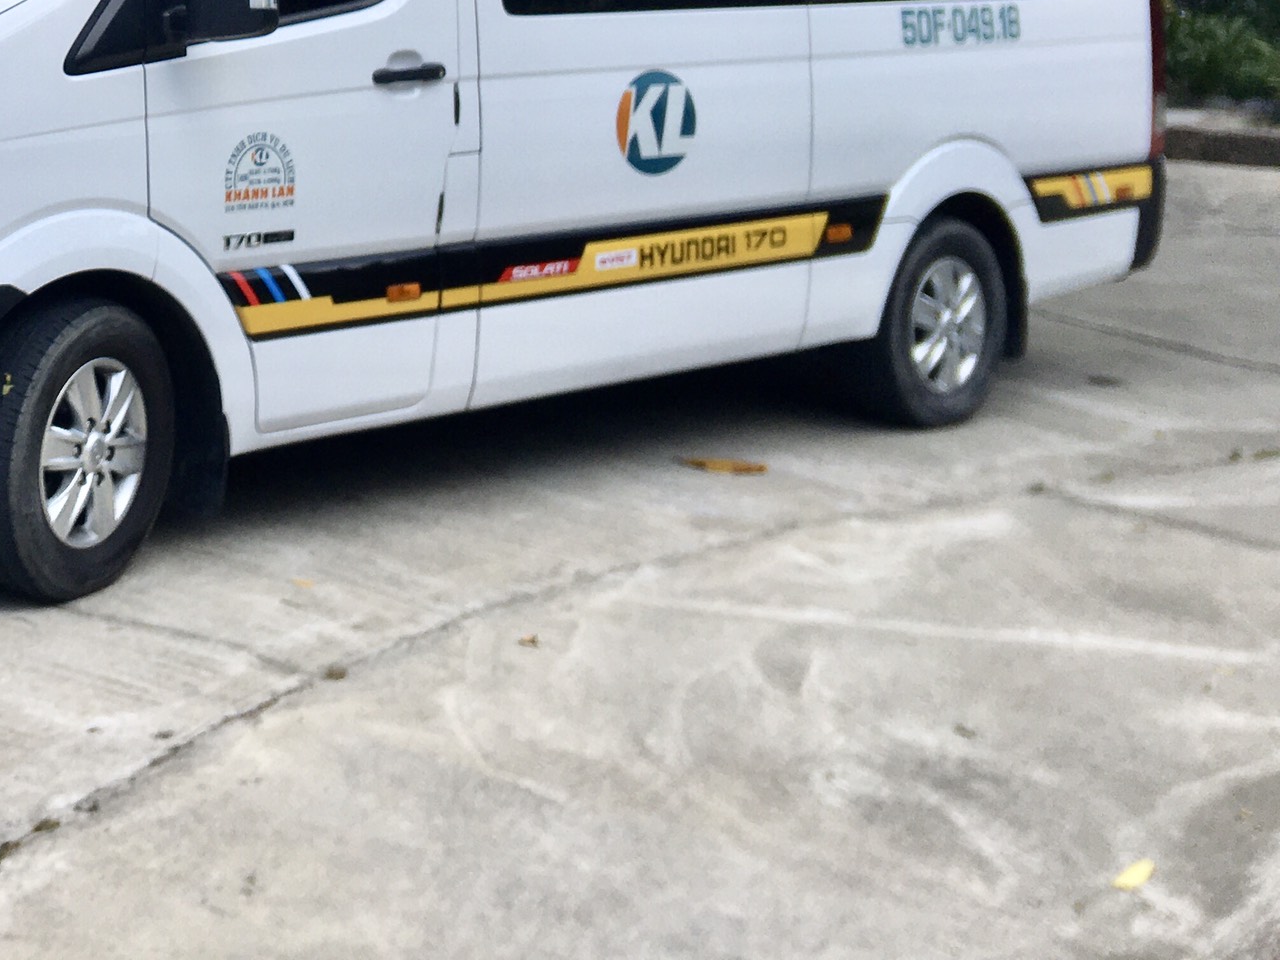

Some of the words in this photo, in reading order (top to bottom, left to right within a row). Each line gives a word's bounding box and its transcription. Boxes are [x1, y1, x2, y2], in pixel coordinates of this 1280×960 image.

[618, 76, 696, 168] KL
[272, 185, 295, 198] LAN
[639, 234, 736, 268] HYUNDAI
[745, 226, 787, 251] 170
[511, 261, 569, 280] SOLATI
